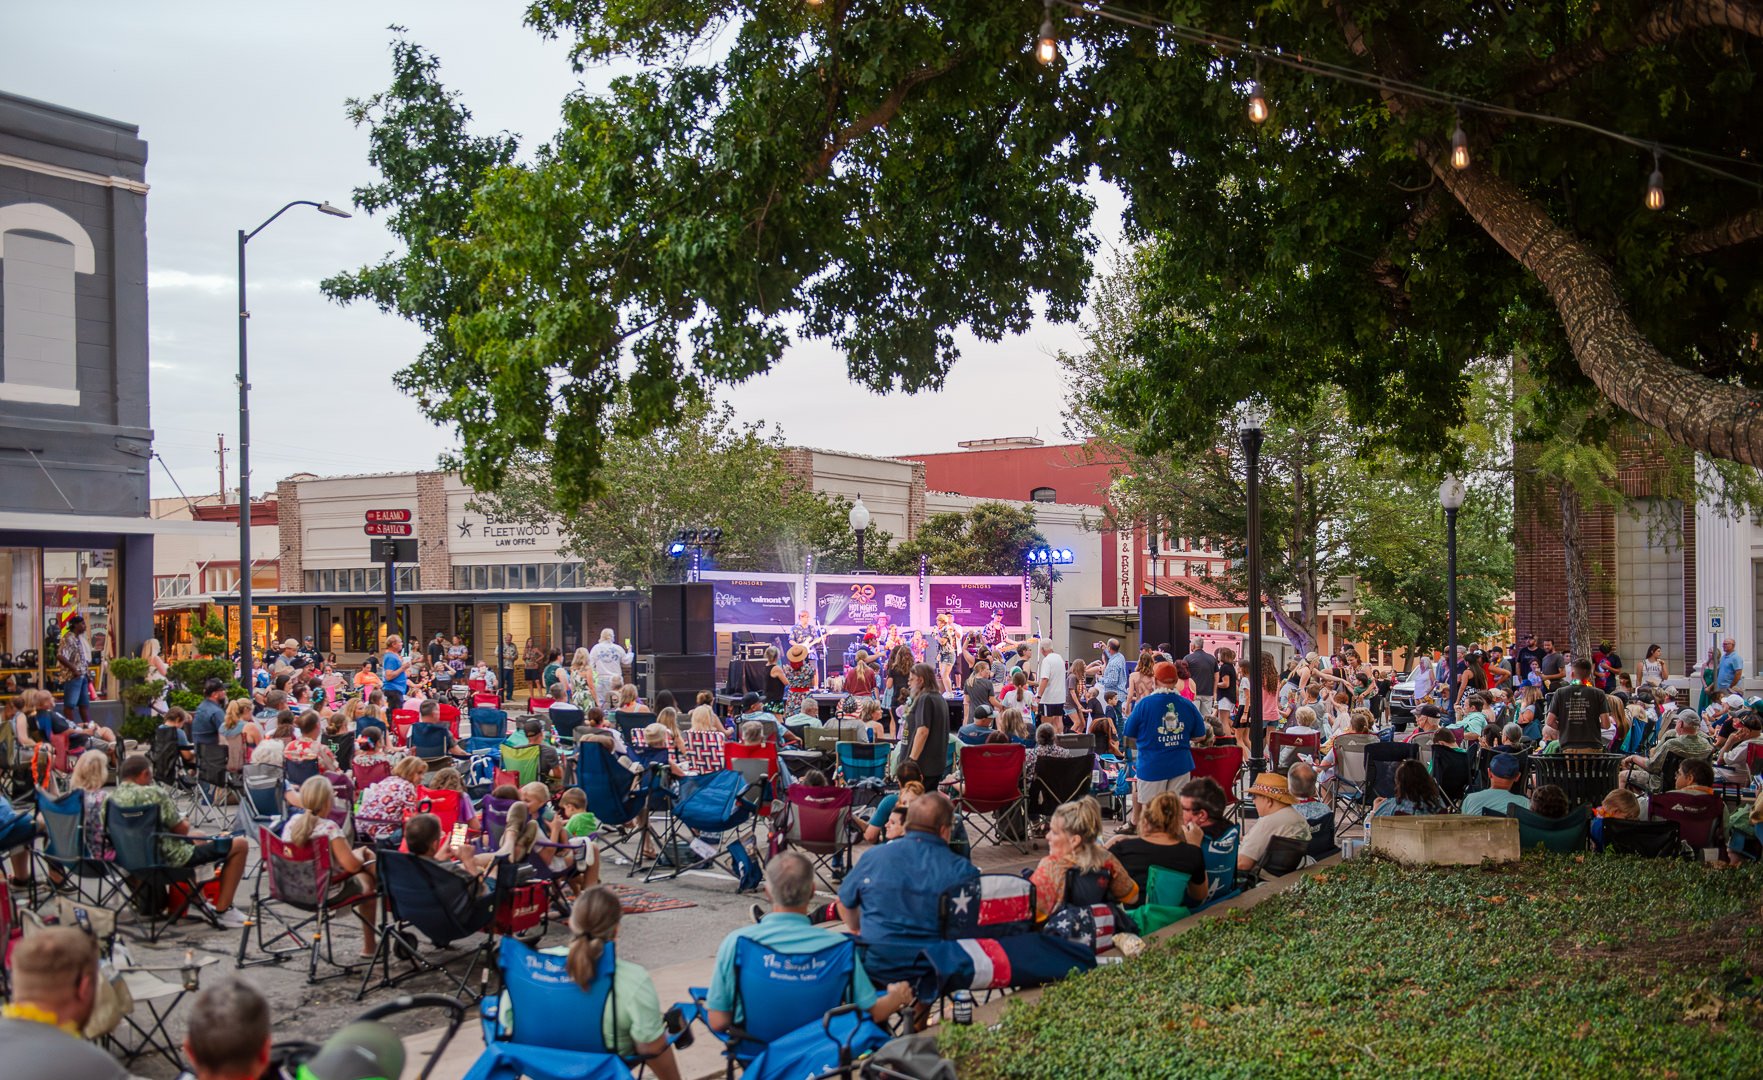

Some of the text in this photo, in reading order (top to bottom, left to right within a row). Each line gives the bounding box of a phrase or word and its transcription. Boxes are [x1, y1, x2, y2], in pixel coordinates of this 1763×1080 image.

[382, 510, 404, 520] ALAMO
[382, 524, 405, 534] BAYLOR
[483, 526, 550, 537] FLEETWOOD
[512, 538, 536, 546] OFFICE
[751, 596, 782, 604] valmont
[946, 594, 962, 608] big
[980, 600, 1019, 609] BRIANNAS
